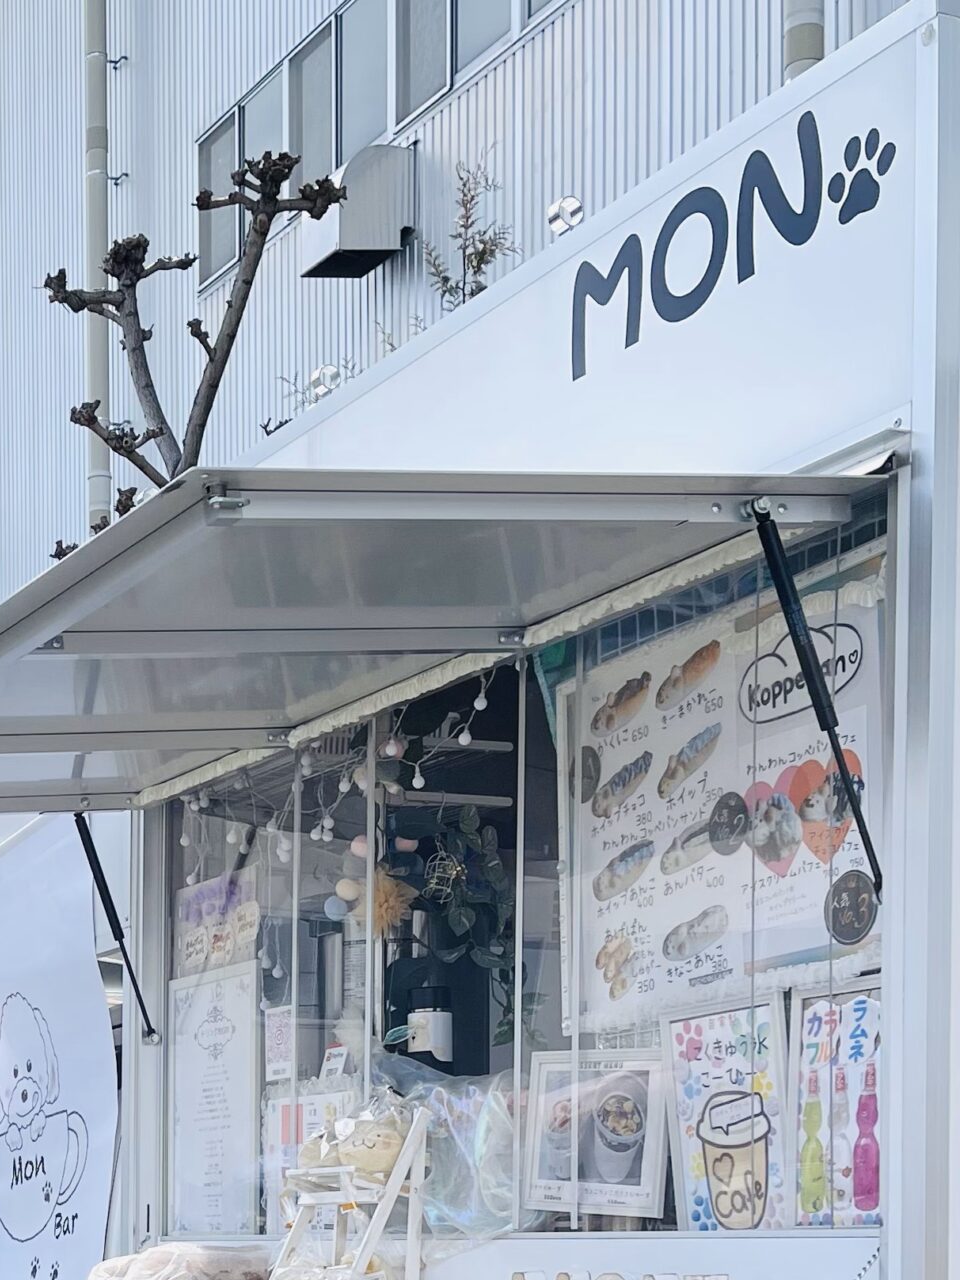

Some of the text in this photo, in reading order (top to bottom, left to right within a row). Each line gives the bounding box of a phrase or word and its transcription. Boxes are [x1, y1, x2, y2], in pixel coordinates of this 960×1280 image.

[572, 110, 823, 381] MON
[748, 655, 846, 712] Koppean
[705, 696, 723, 714] 650
[631, 726, 650, 742] 650
[746, 733, 857, 775] わんわんコッペパンフェ
[666, 770, 709, 811] ホイップ
[705, 787, 724, 803] 350
[591, 794, 646, 837] ホイップチョコ
[635, 811, 653, 827] 380
[663, 866, 715, 896] あんバター
[854, 893, 870, 929] 3
[711, 958, 728, 973] 380
[637, 977, 655, 994] 350
[848, 999, 869, 1064] ラムネ
[10, 1155, 47, 1189] Mon
[54, 1212, 79, 1240] Bar
